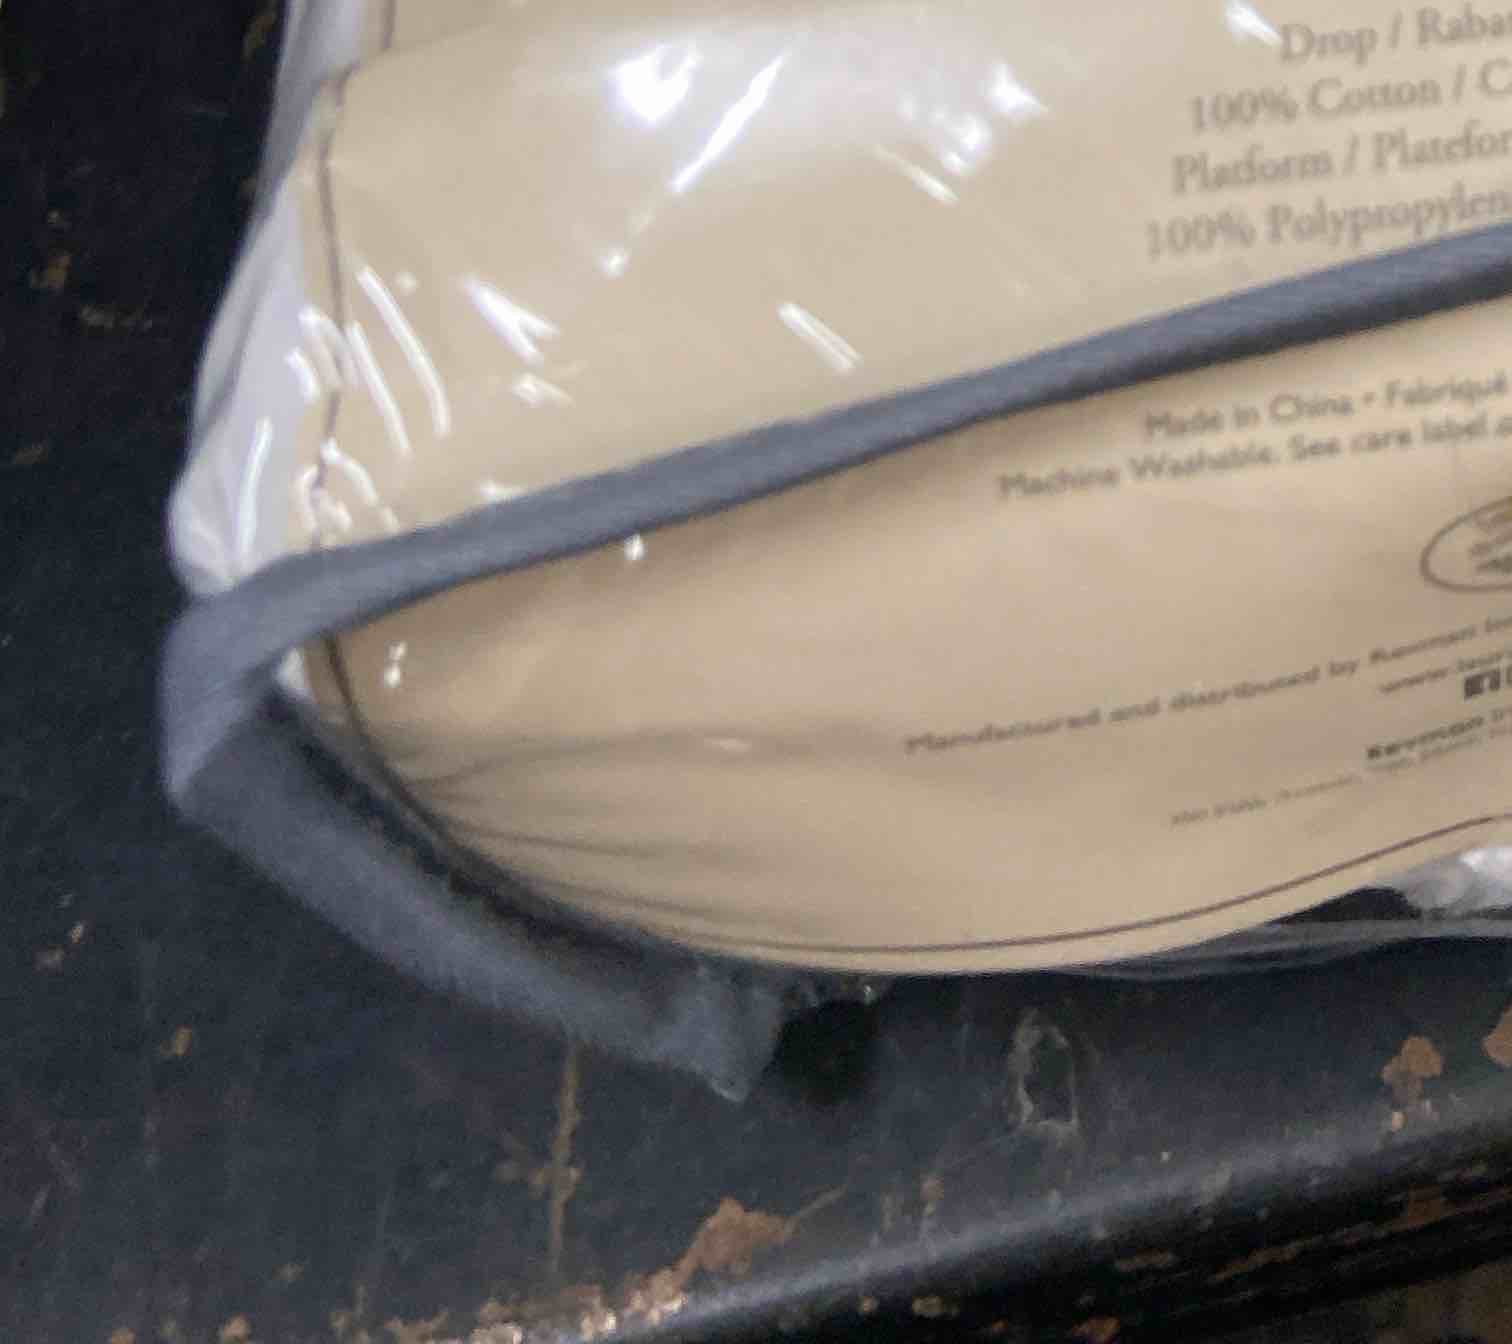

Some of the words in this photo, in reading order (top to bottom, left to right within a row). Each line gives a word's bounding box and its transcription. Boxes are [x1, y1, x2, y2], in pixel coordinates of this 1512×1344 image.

[1280, 23, 1379, 64] Drop
[1187, 86, 1299, 133] 100%
[1308, 77, 1442, 115] Cotton
[1172, 144, 1334, 196] Platform
[1146, 208, 1256, 263] 100%
[1146, 410, 1223, 438] Made
[1232, 403, 1260, 429] in
[1269, 392, 1354, 423] China
[997, 467, 1120, 498] Machine
[1288, 433, 1341, 460] See
